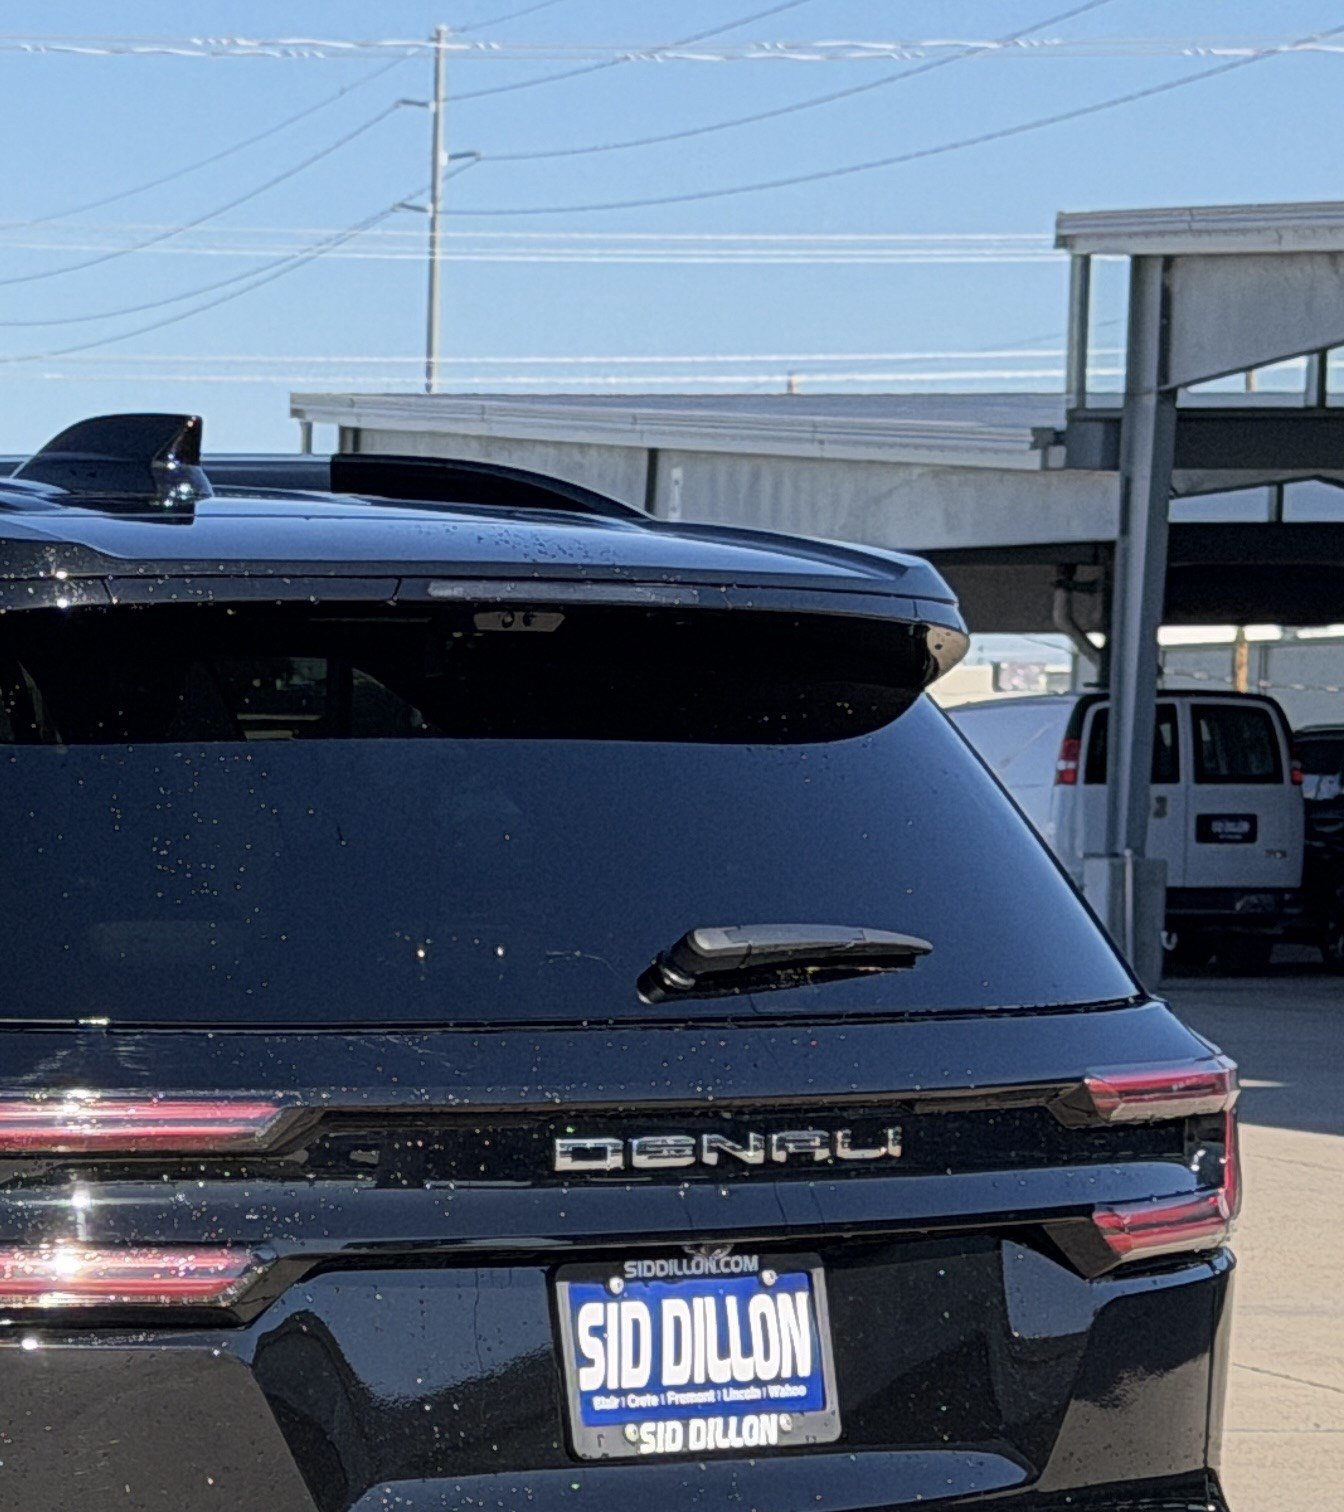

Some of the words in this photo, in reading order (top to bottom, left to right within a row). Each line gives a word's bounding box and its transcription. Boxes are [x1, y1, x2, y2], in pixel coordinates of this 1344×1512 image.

[554, 1126, 903, 1172] DENALI
[624, 1254, 759, 1279] SIDDILLON.COM
[577, 1300, 653, 1392] SID
[661, 1291, 811, 1386] DILLON
[638, 1421, 683, 1454] SID
[688, 1414, 779, 1451] DILLON
